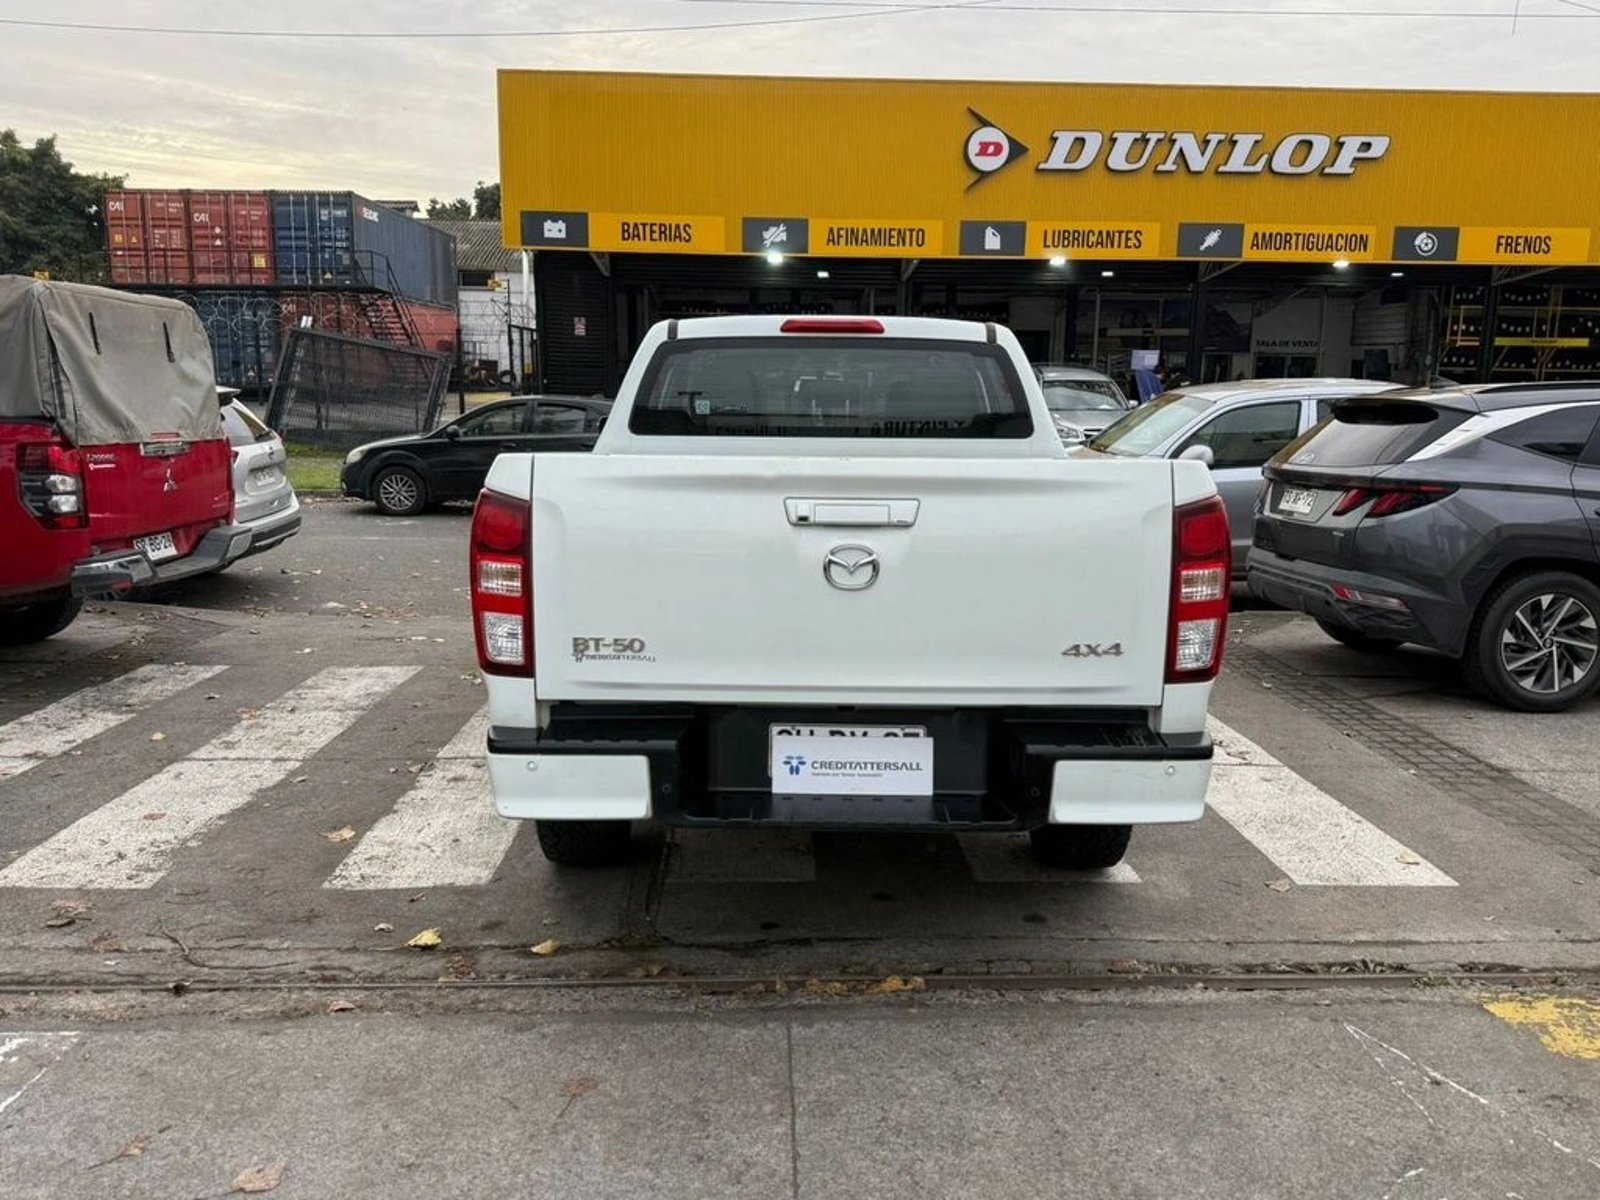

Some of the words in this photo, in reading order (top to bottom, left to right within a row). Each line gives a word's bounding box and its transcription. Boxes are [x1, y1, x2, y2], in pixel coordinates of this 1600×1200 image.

[974, 141, 1004, 157] D
[1036, 129, 1391, 176] DUNLOP
[621, 221, 692, 243] BATERIAS
[826, 226, 925, 248] AFINAMIENTO
[1043, 229, 1143, 249] LUBRICANTES
[1250, 231, 1368, 252] AMORTIGUACION
[1495, 235, 1552, 254] FRENOS
[572, 636, 646, 653] BT-50
[810, 760, 923, 772] CREDITATTERSALL
